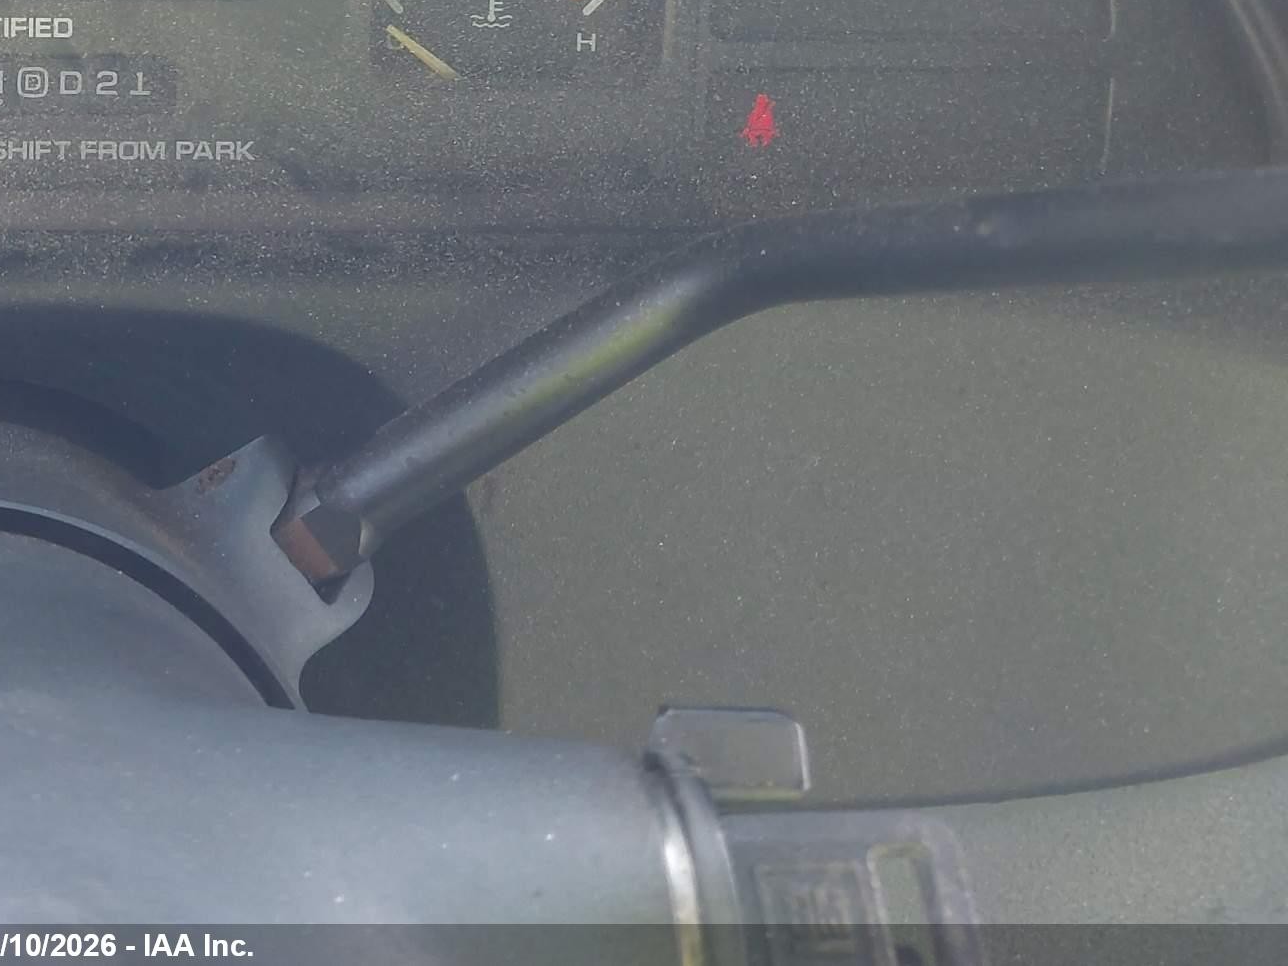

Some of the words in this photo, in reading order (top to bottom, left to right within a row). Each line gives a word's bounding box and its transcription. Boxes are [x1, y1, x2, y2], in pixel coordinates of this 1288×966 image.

[577, 33, 596, 52] H
[59, 70, 83, 95] D
[95, 70, 118, 96] 2
[80, 140, 166, 161] FROM
[175, 140, 255, 161] PARK
